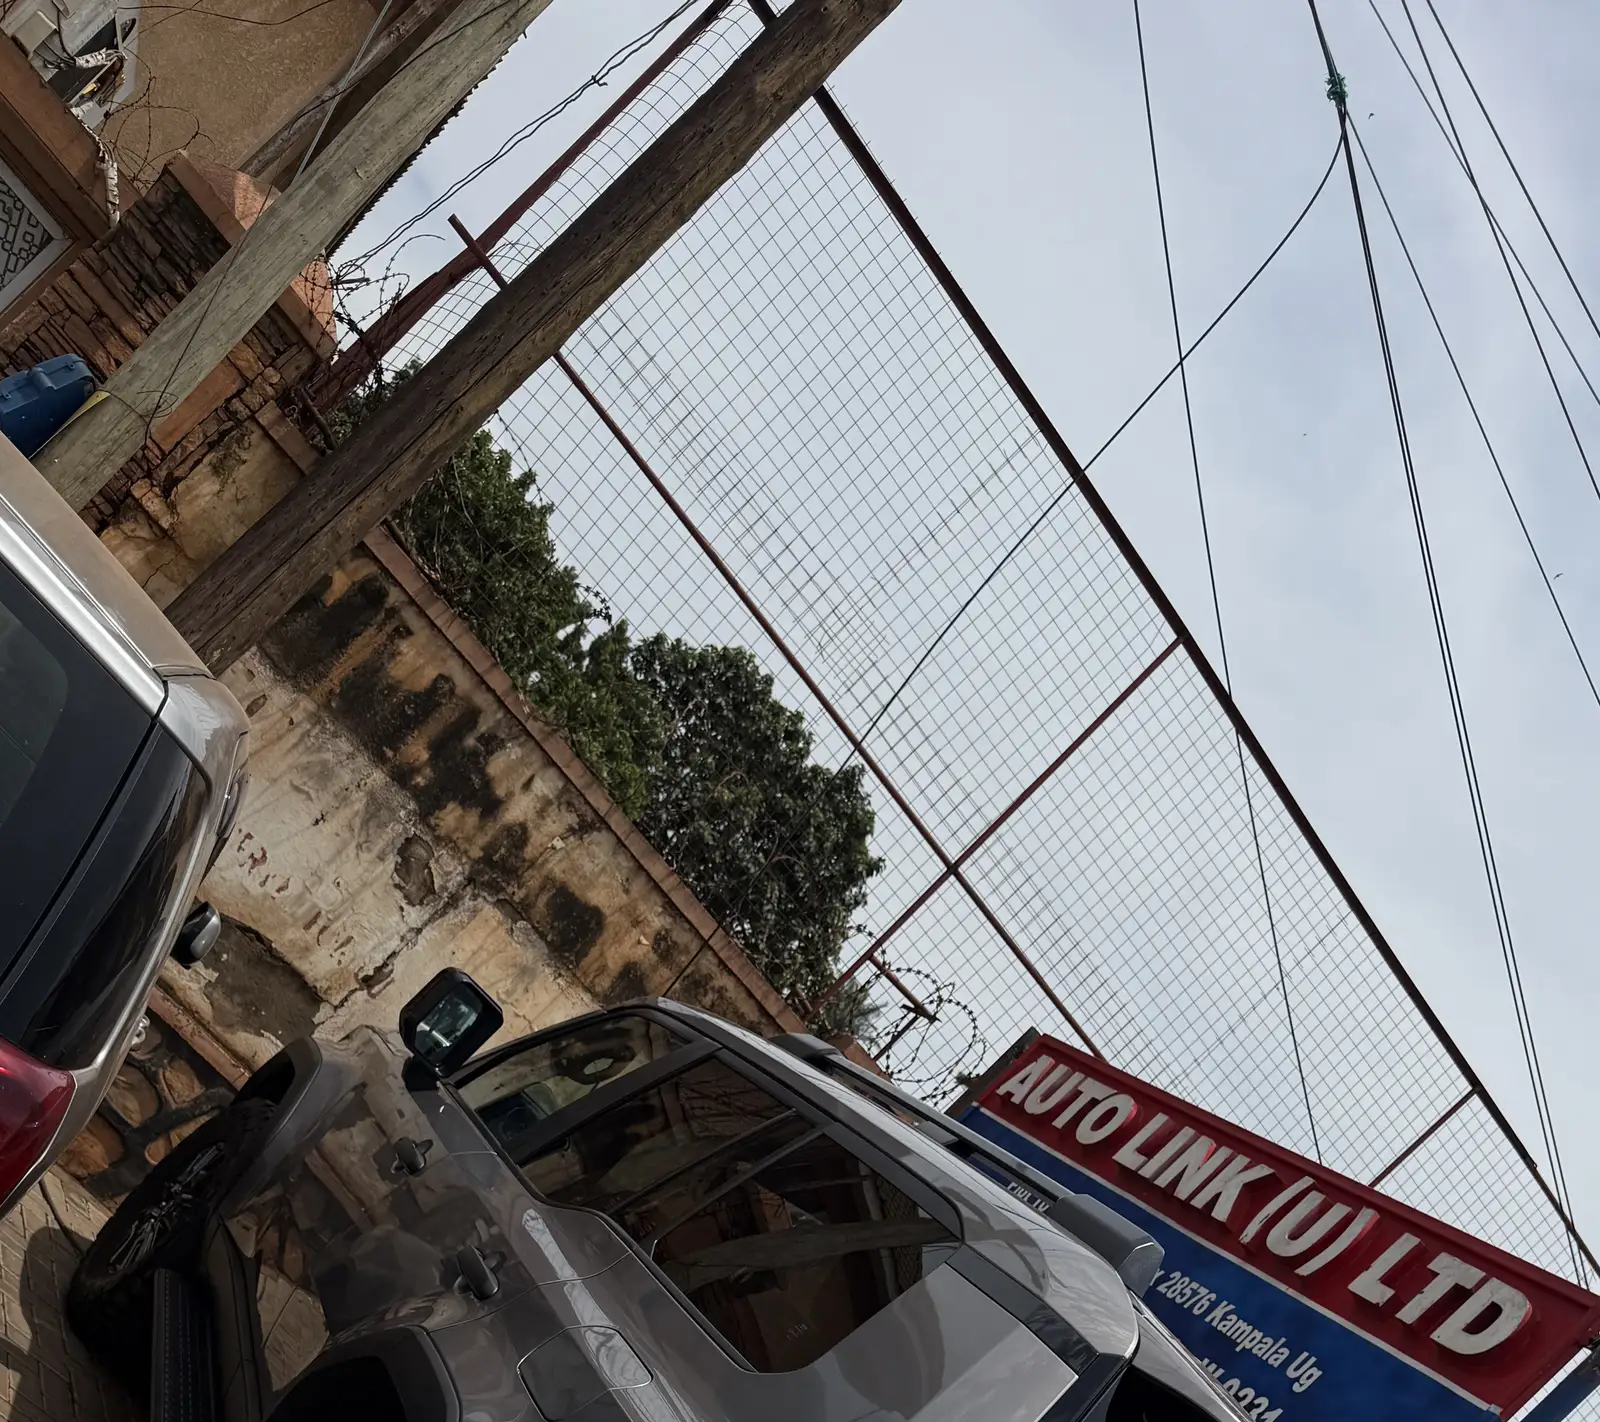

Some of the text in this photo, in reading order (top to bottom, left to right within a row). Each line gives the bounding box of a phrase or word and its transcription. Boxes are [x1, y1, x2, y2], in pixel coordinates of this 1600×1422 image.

[995, 1054, 1533, 1355] AUTO LINK (U) LTD
[1156, 1270, 1217, 1316] 28576
[1204, 1300, 1290, 1369] Kampala
[1286, 1351, 1323, 1393] Ug
